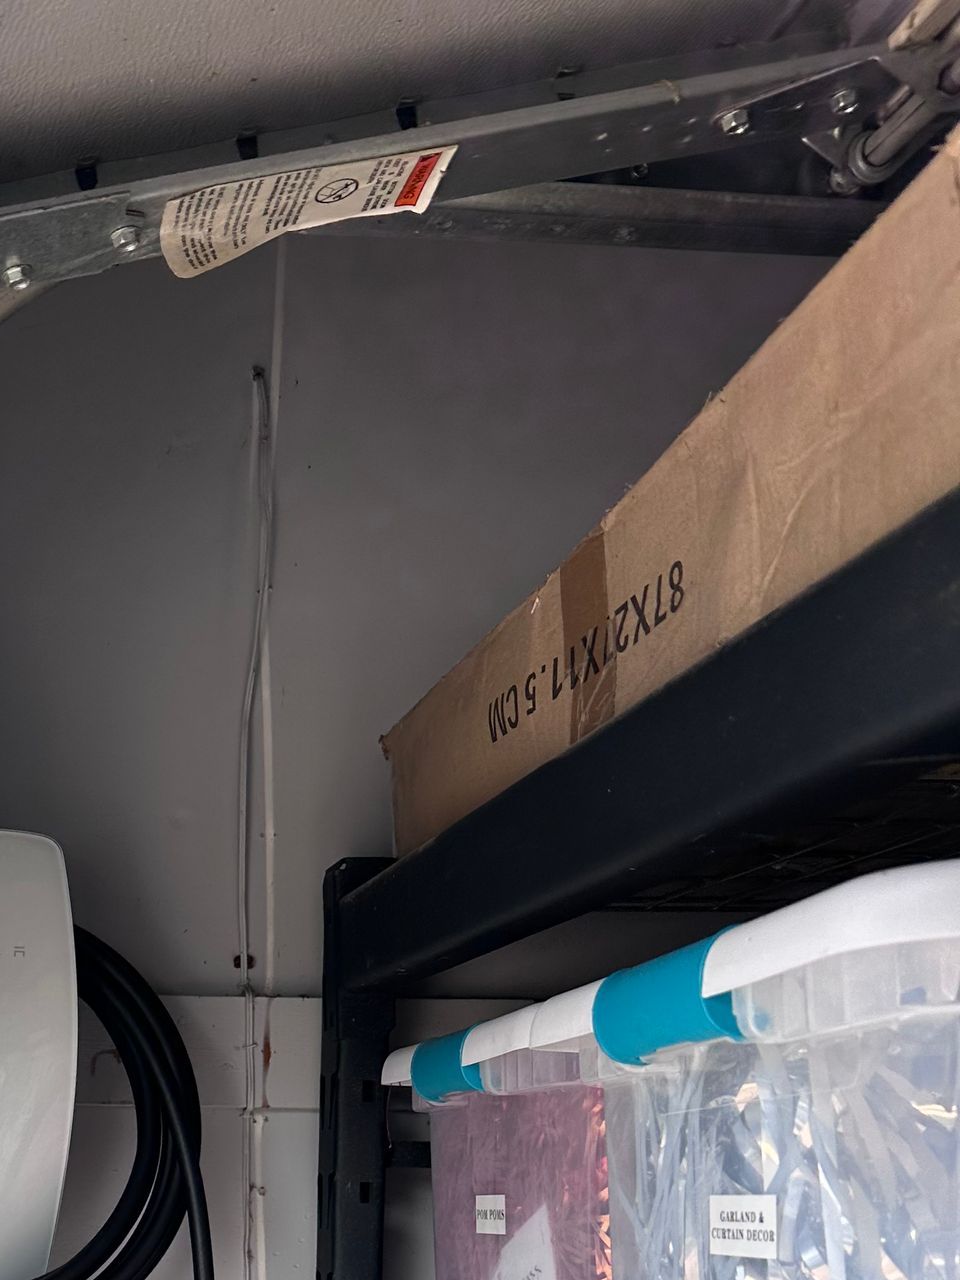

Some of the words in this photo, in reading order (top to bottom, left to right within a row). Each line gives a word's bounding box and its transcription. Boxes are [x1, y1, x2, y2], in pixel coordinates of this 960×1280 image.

[476, 1208, 488, 1221] POM
[489, 1208, 505, 1221] POMS
[719, 1210, 757, 1223] GARLAND
[758, 1210, 765, 1224] &
[711, 1227, 745, 1241] CURTAIN
[746, 1229, 776, 1243] DECOR
